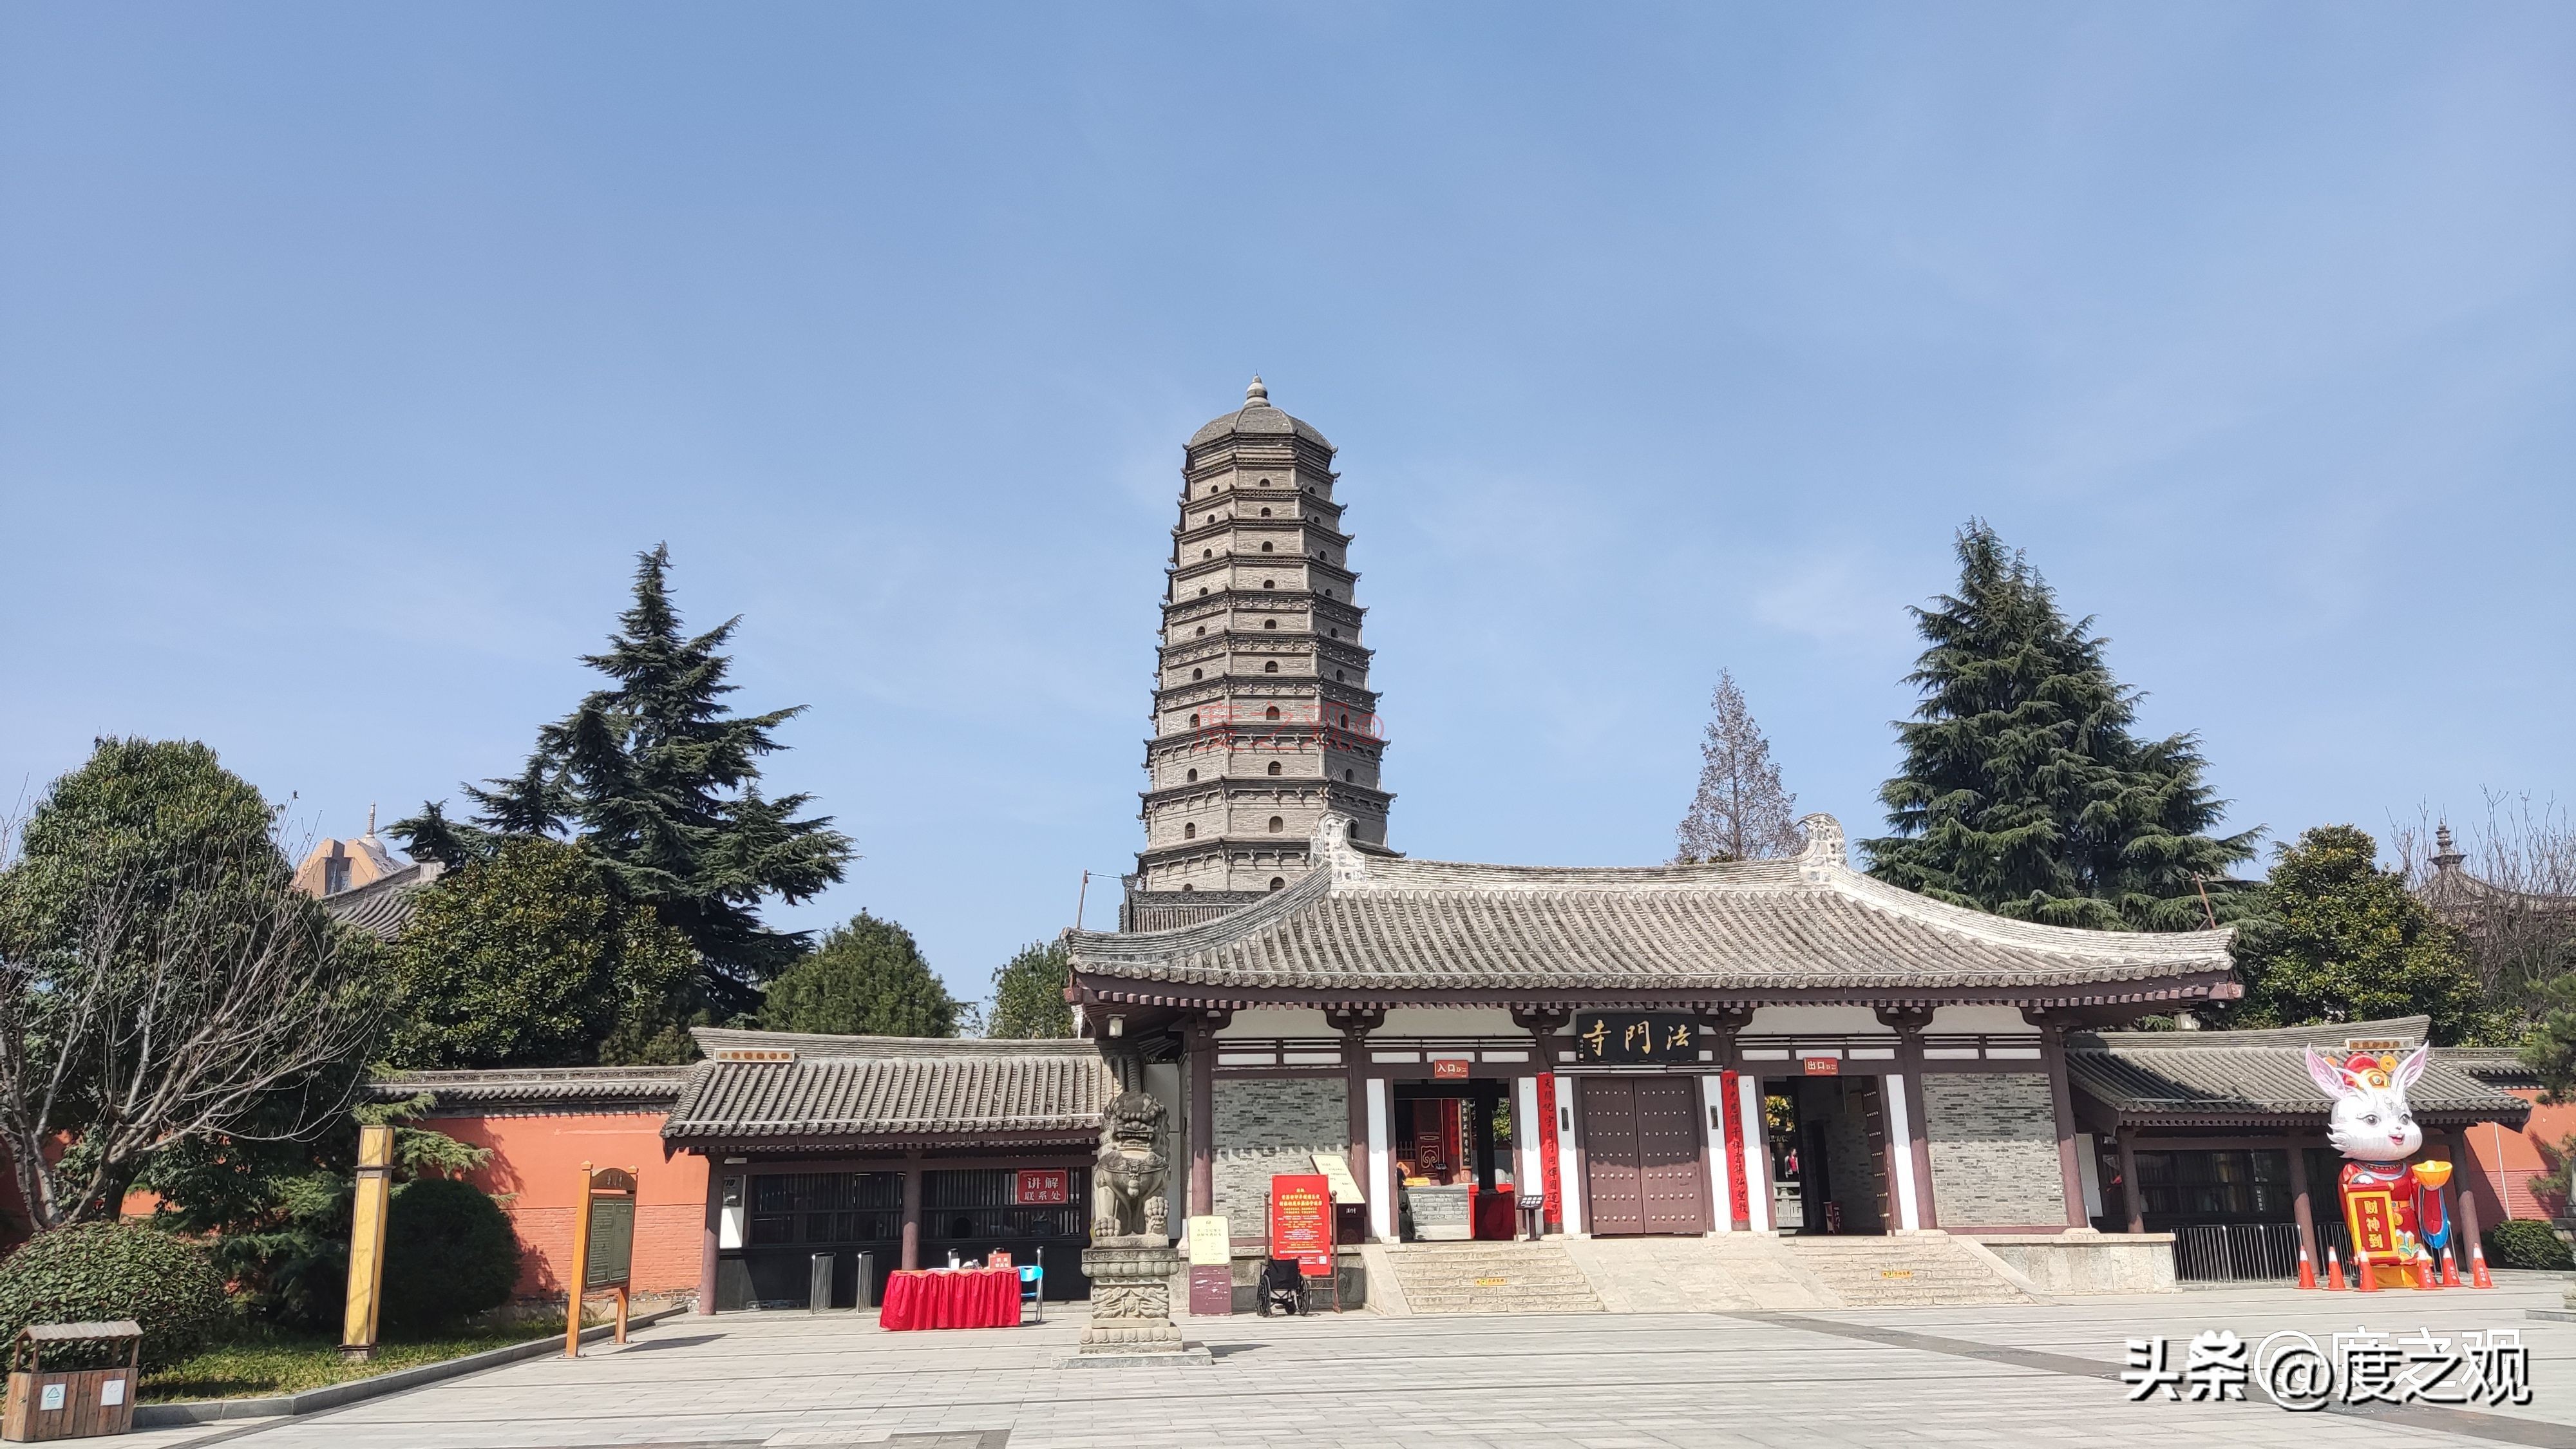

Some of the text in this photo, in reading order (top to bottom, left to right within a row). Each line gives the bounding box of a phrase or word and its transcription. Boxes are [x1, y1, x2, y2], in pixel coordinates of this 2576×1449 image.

[1582, 1019, 1692, 1056] 法門寺
[1437, 1063, 1455, 1072] 入口
[1808, 1061, 1824, 1070] 出口
[1027, 1177, 1059, 1189] 讲解
[1024, 1191, 1061, 1201] 联系处
[2363, 1200, 2383, 1248] 财神到
